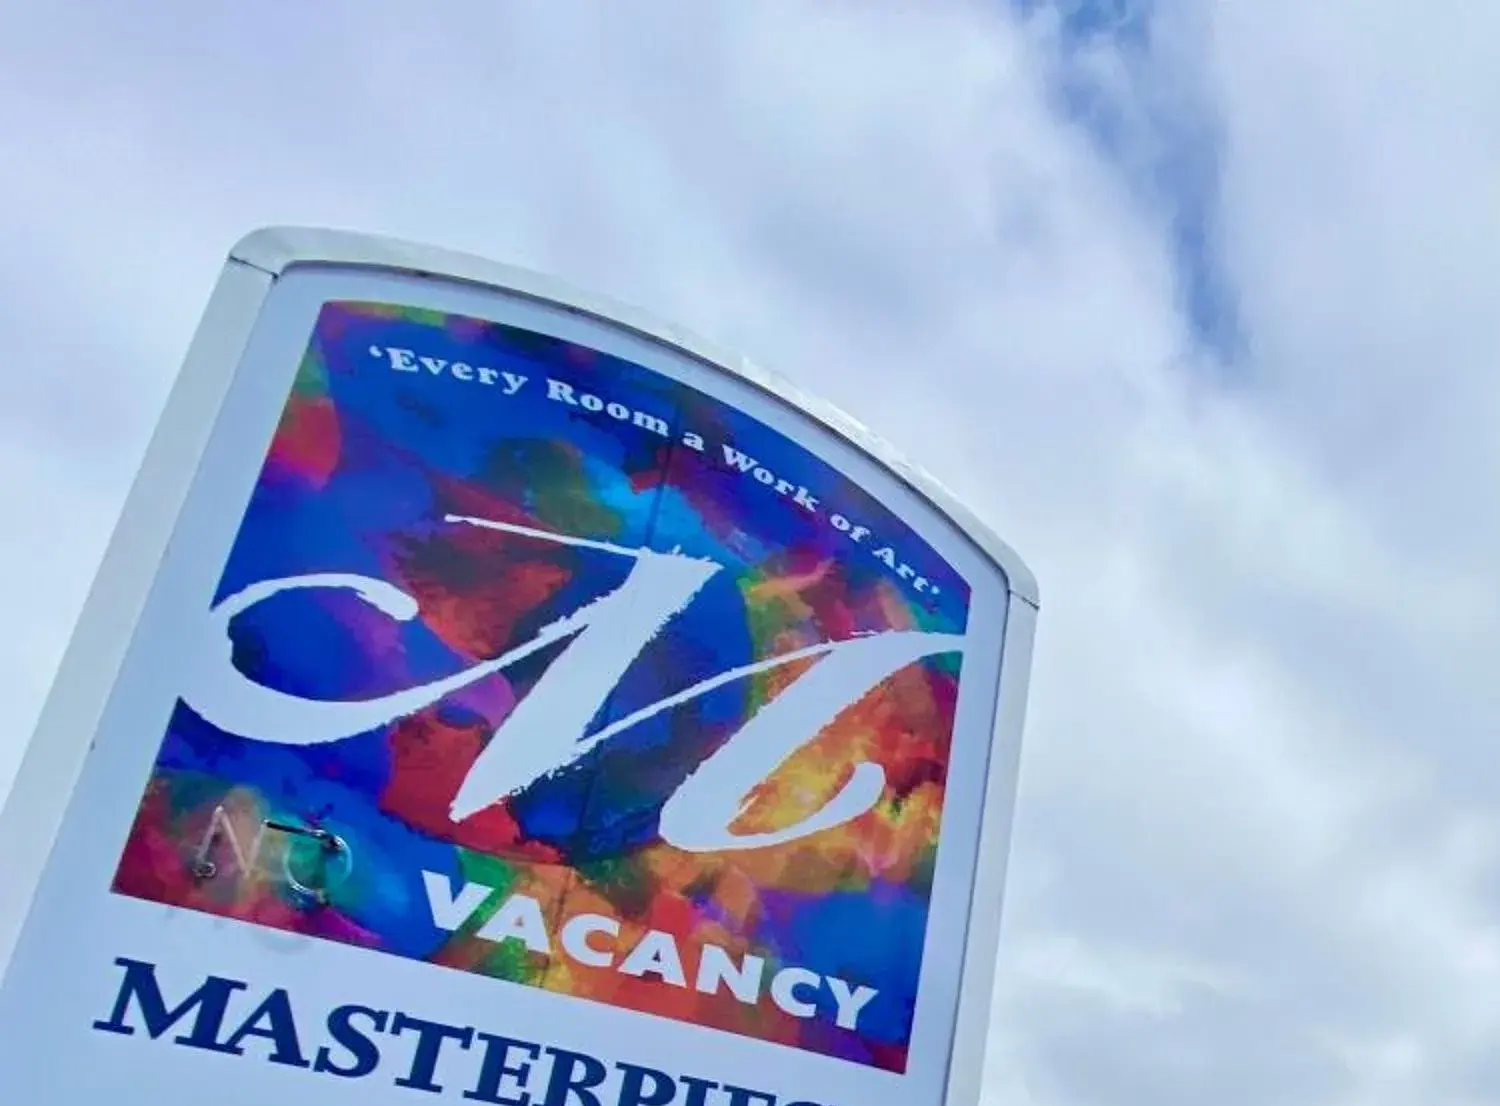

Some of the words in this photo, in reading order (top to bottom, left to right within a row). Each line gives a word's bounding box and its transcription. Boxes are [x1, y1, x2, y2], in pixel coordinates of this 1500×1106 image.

[545, 377, 670, 438] Room
[682, 431, 705, 452] a
[721, 443, 821, 513] Work
[829, 513, 872, 544] of
[419, 870, 880, 1034] VACANCY
